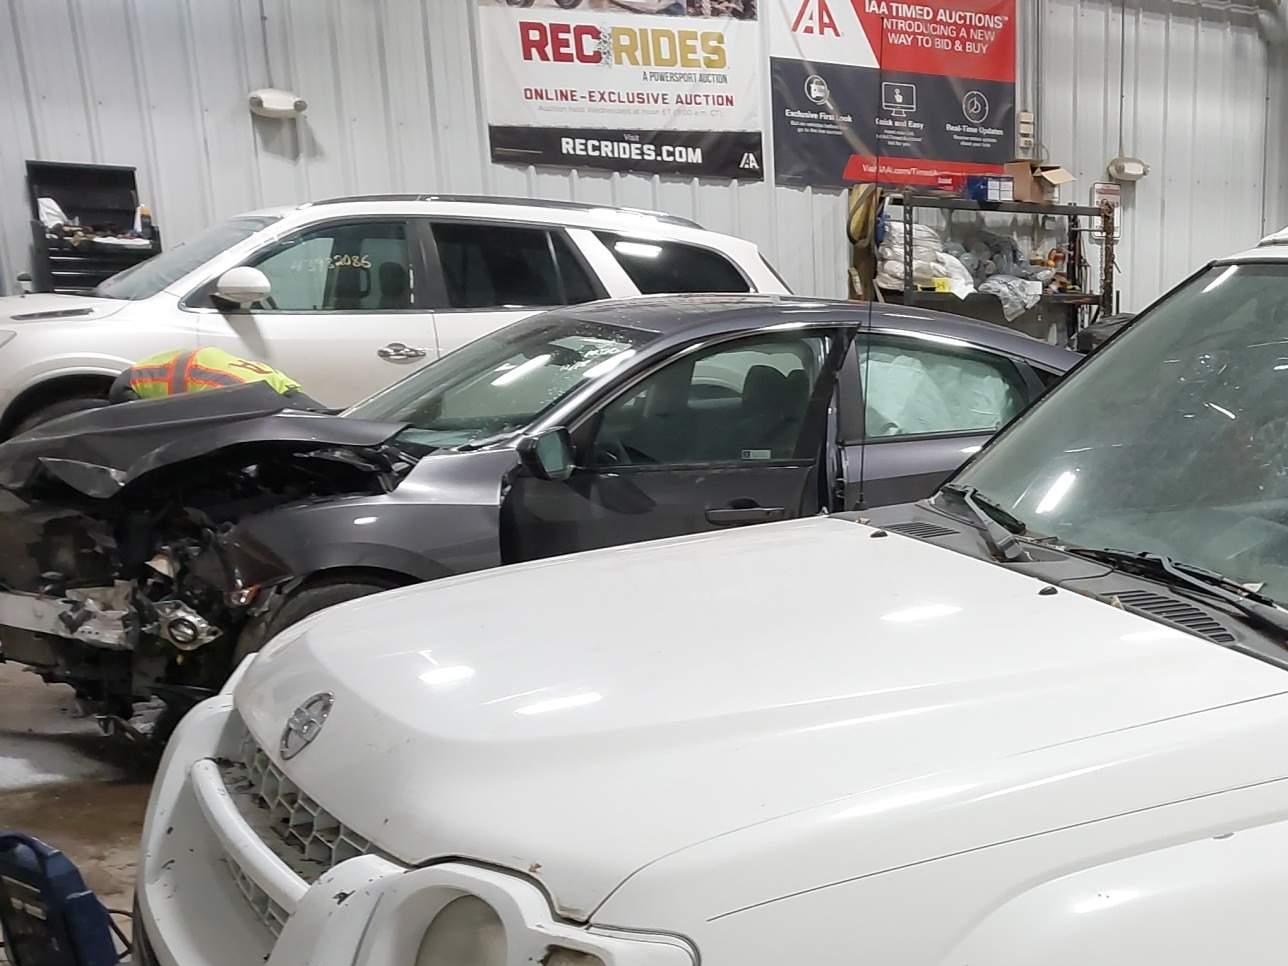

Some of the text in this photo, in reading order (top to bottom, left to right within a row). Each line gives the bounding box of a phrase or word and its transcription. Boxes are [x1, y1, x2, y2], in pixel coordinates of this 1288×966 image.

[864, 0, 888, 15] IAA
[889, 2, 933, 21] TIMED
[882, 18, 996, 41] NTRODUCING A NEW
[519, 21, 727, 69] REC RIDES
[888, 32, 989, 54] WAY TO BID & BUY
[642, 71, 648, 81] A
[698, 73, 728, 84] AUCTION
[523, 87, 735, 107] ONLINE-EXCLUSIVE AUCTION
[908, 120, 924, 130] Easy
[561, 137, 703, 164] RECRIDES.COM
